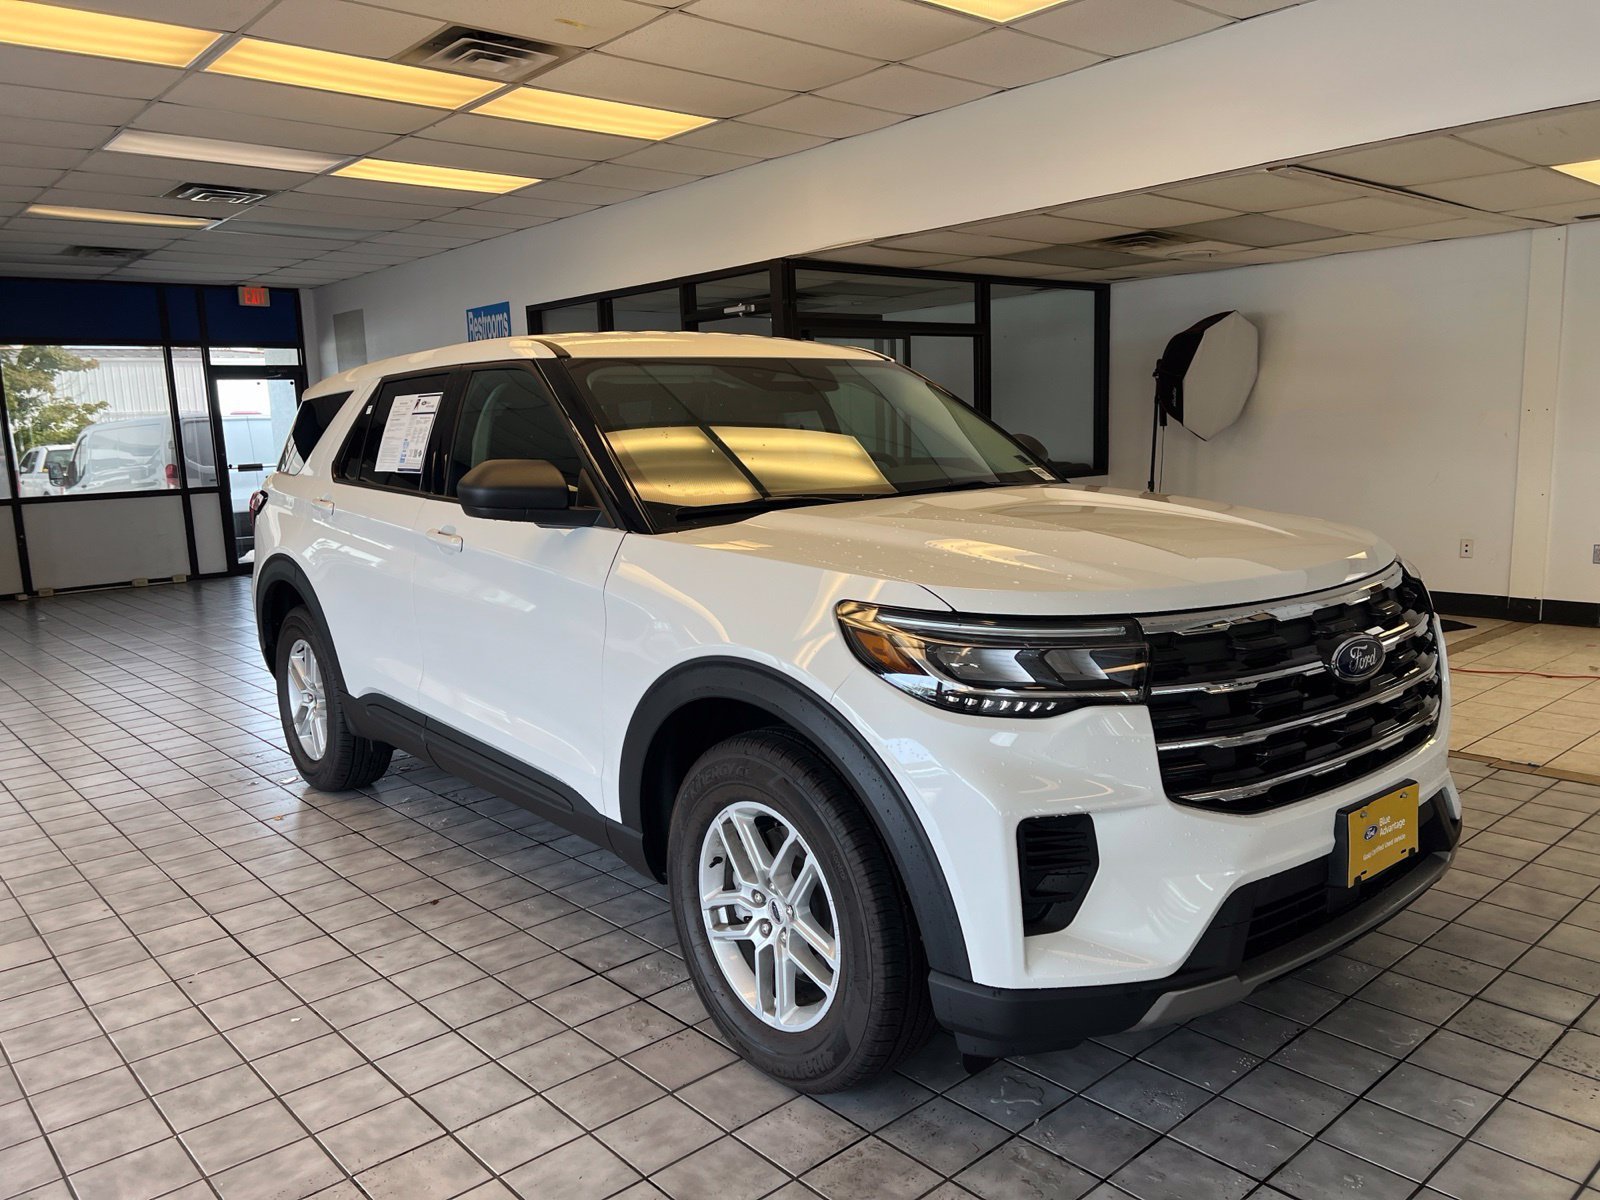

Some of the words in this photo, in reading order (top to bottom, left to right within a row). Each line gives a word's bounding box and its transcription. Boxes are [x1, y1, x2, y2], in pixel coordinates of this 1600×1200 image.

[244, 287, 265, 305] EXIT
[468, 311, 509, 341] Restrooms
[1349, 644, 1377, 672] Ford
[1379, 816, 1391, 827] Blue
[1379, 818, 1406, 837] Advantage
